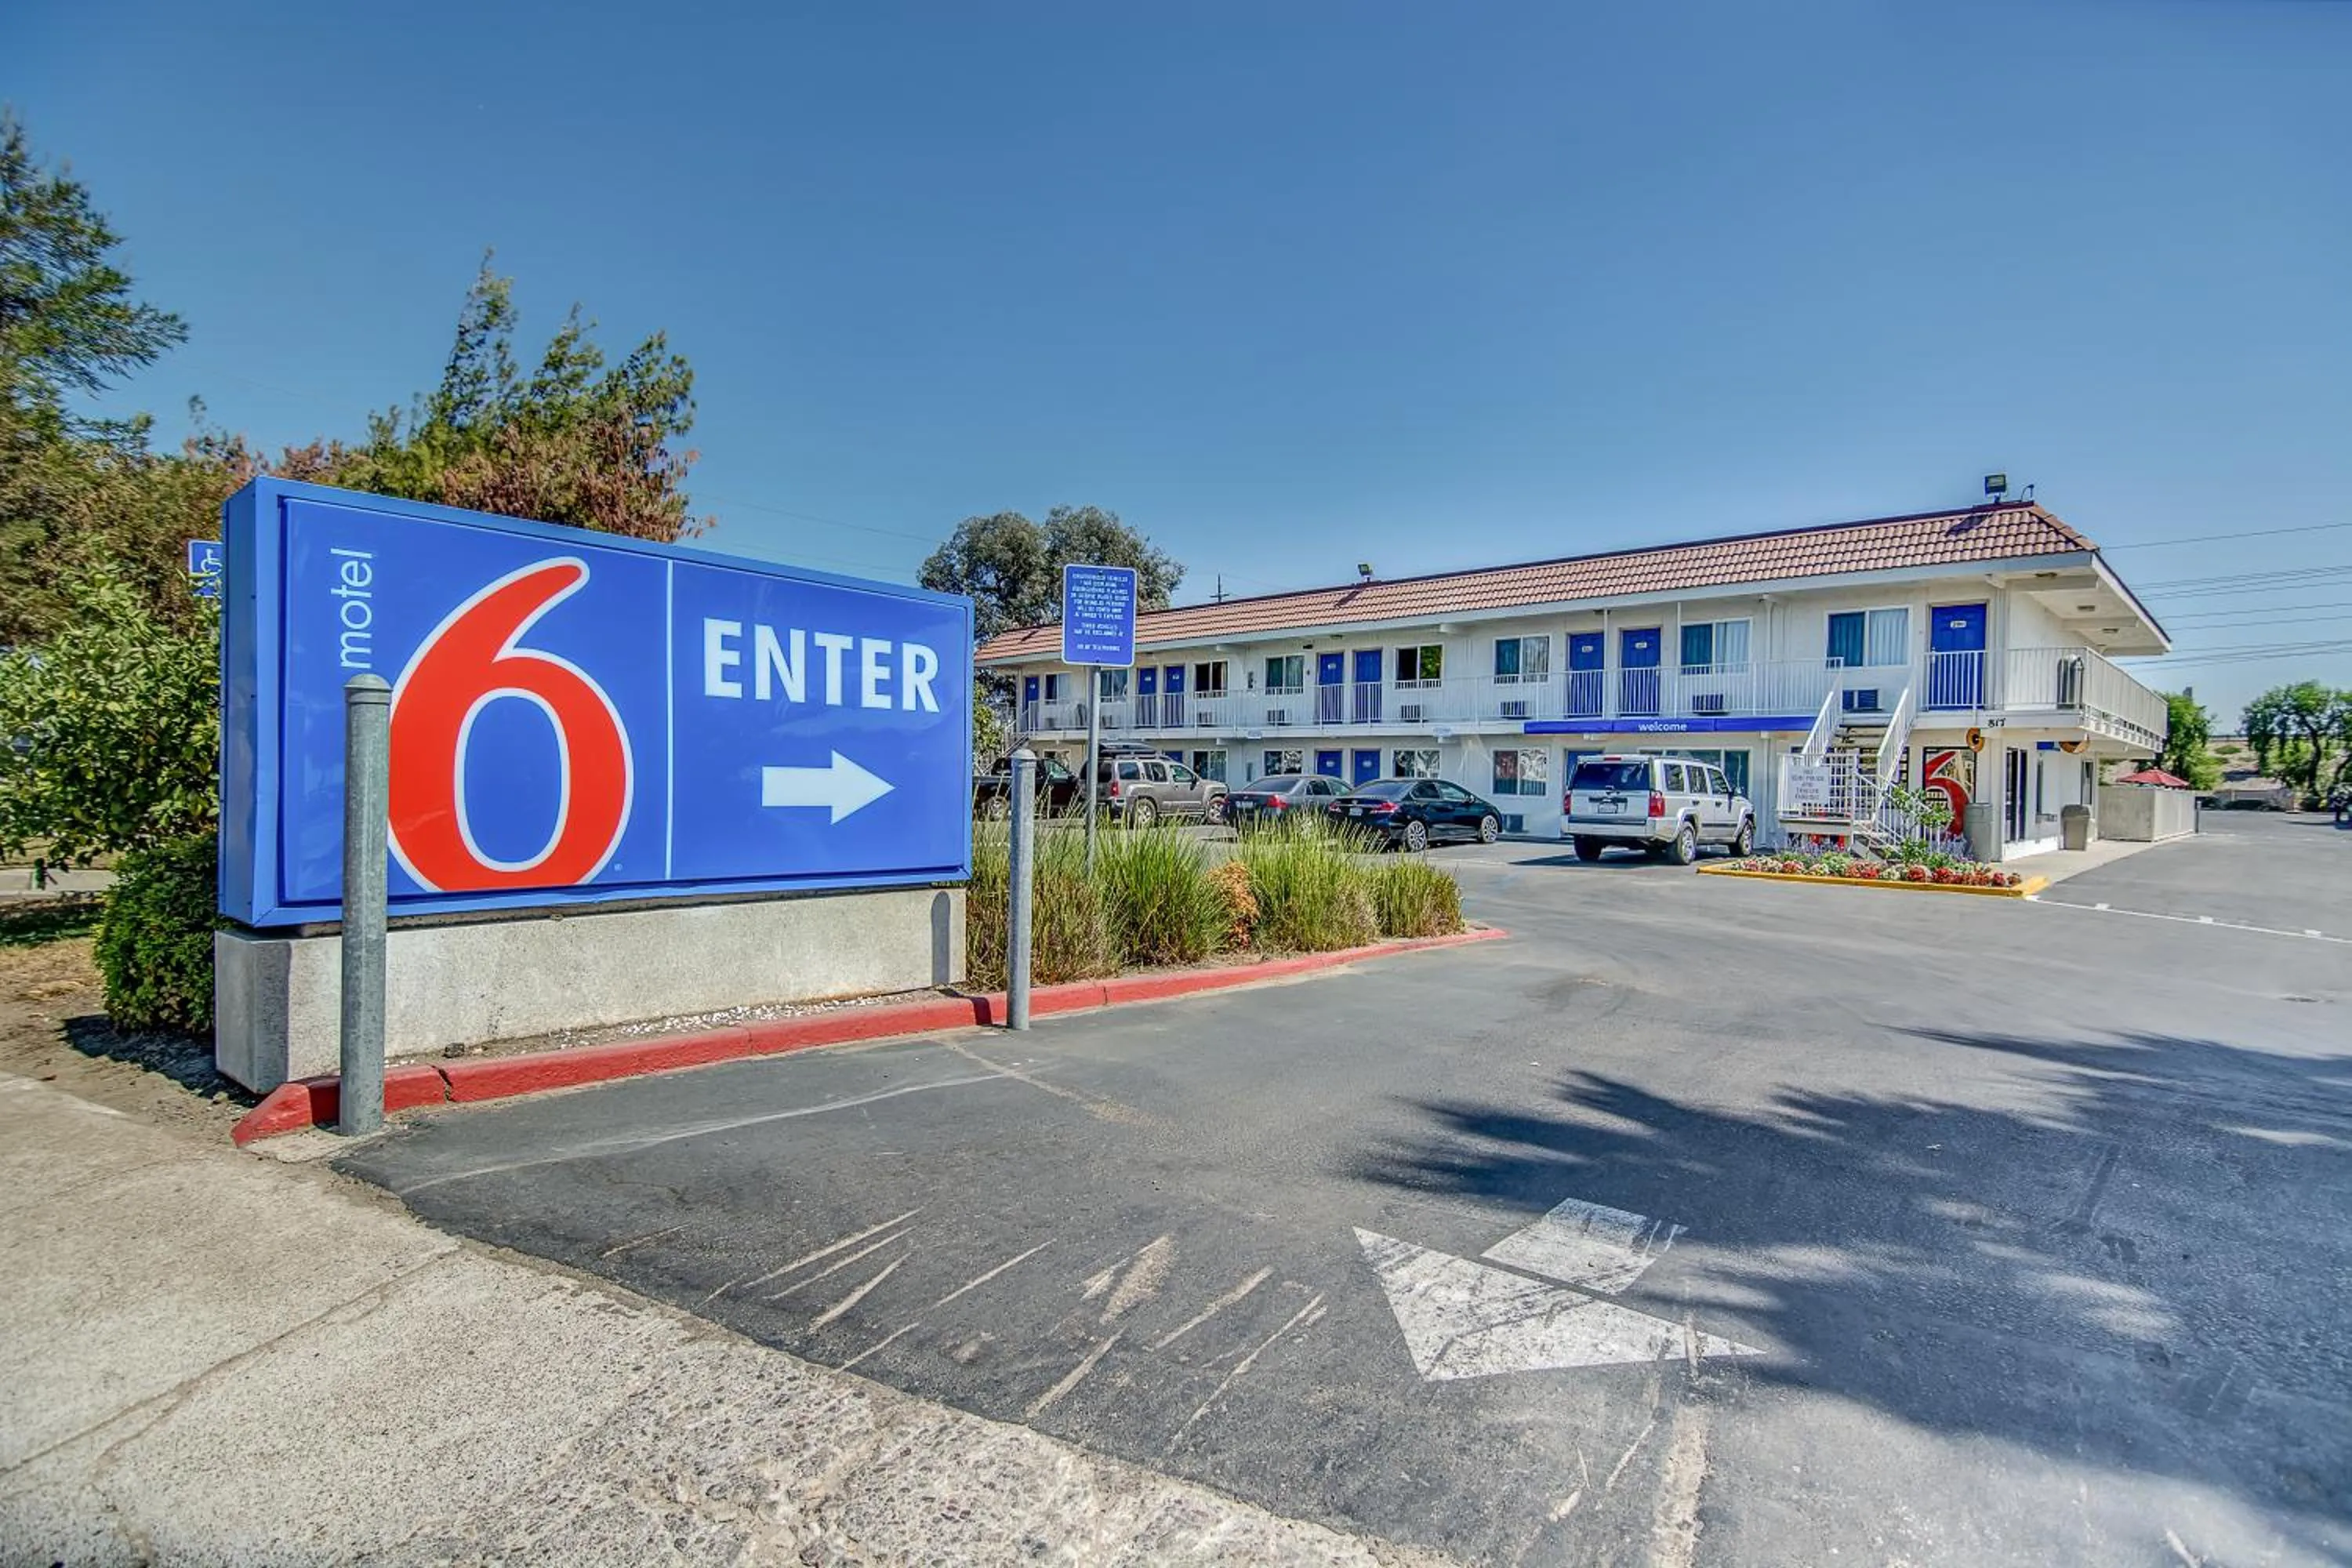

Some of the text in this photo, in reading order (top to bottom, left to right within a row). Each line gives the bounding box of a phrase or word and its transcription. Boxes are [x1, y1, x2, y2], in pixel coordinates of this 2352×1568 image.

[330, 548, 373, 669] motel
[703, 617, 940, 713] ENTER
[387, 557, 634, 892] 6
[1638, 720, 1687, 731] welcome
